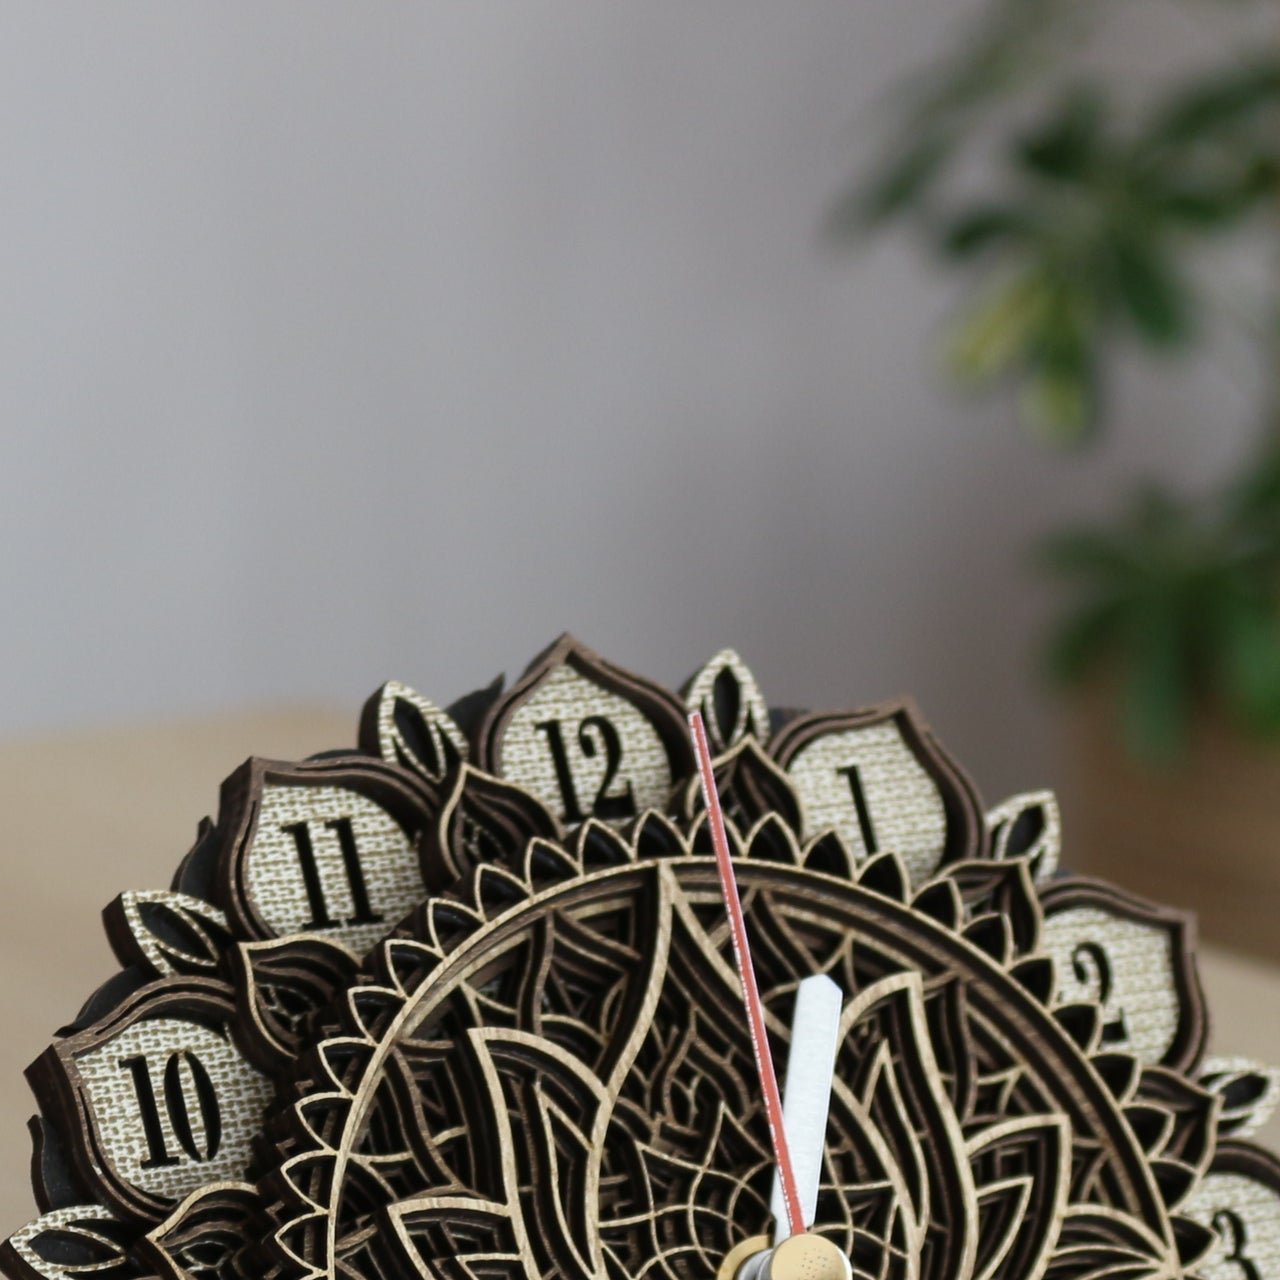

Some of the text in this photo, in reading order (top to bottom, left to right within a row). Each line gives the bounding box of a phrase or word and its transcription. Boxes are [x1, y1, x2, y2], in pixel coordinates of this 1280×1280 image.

[535, 715, 636, 820] 12
[835, 765, 878, 857] 1
[280, 816, 386, 930] 11
[1070, 941, 1129, 1042] 2
[119, 1051, 222, 1169] 10
